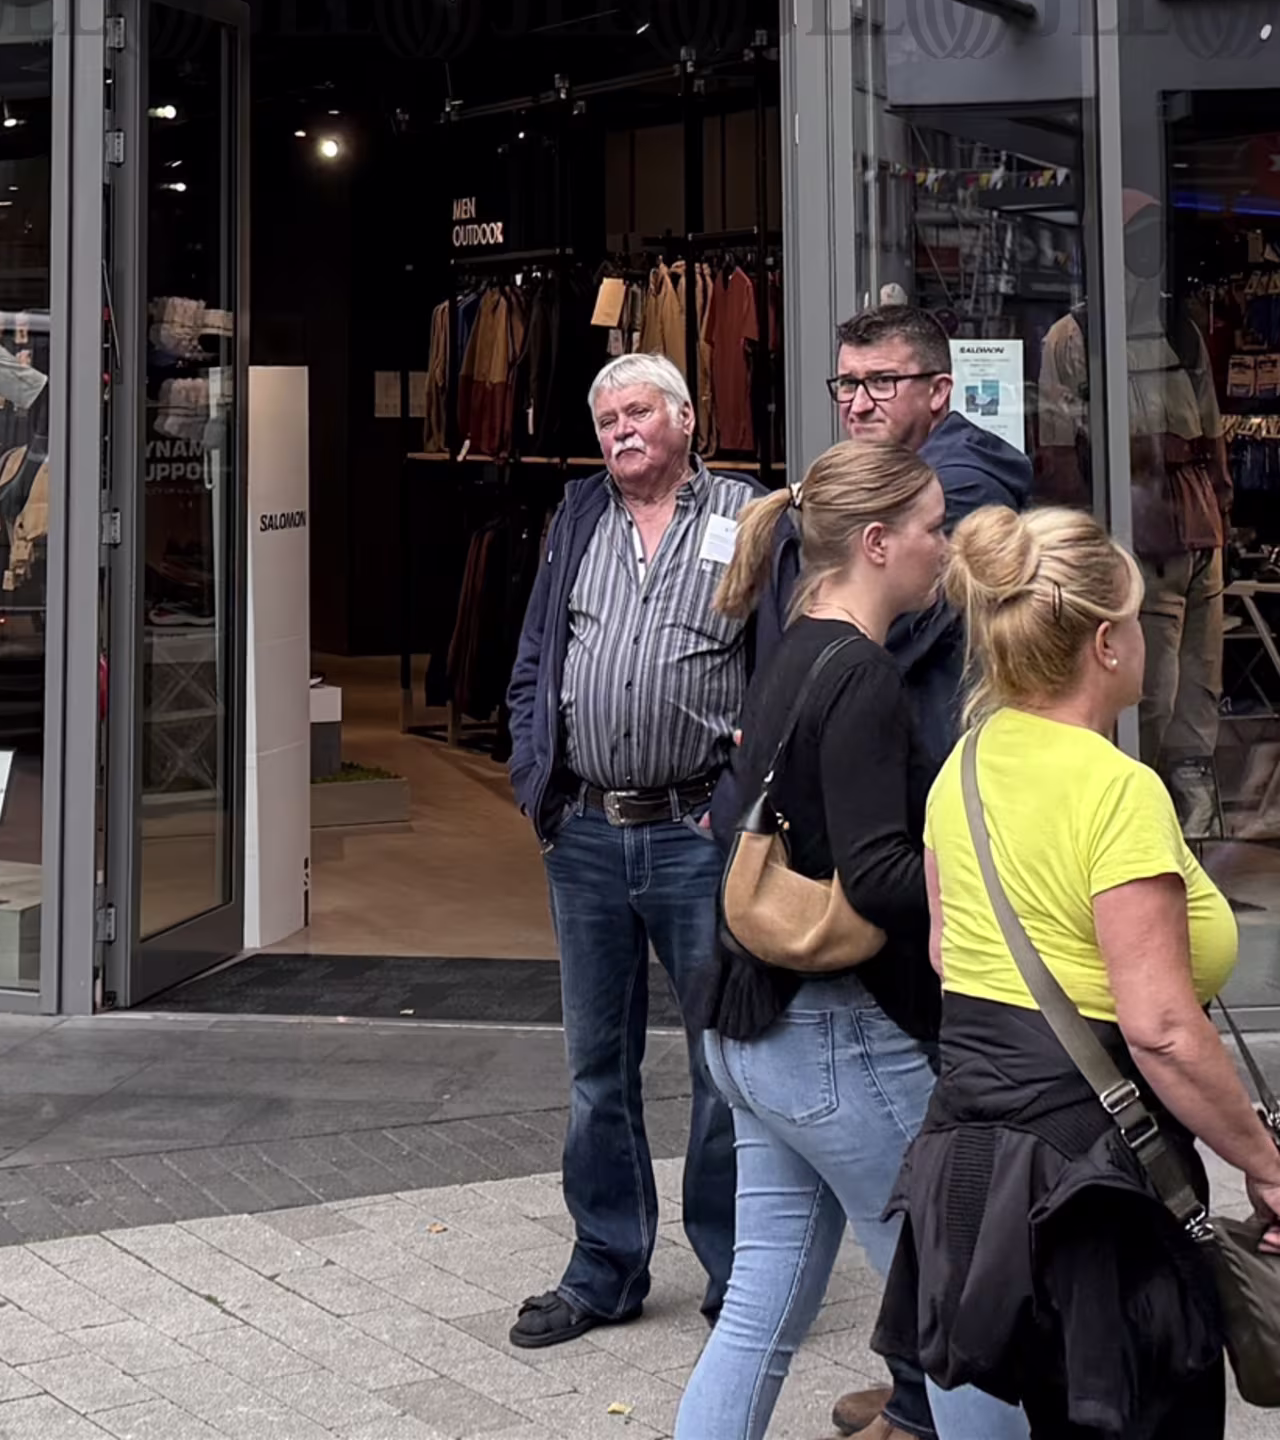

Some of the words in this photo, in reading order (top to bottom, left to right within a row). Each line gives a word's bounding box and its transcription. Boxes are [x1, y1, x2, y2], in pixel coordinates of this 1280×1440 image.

[453, 197, 476, 220] MEN
[453, 222, 503, 247] OUTDOOR
[259, 511, 307, 532] SALOMON
